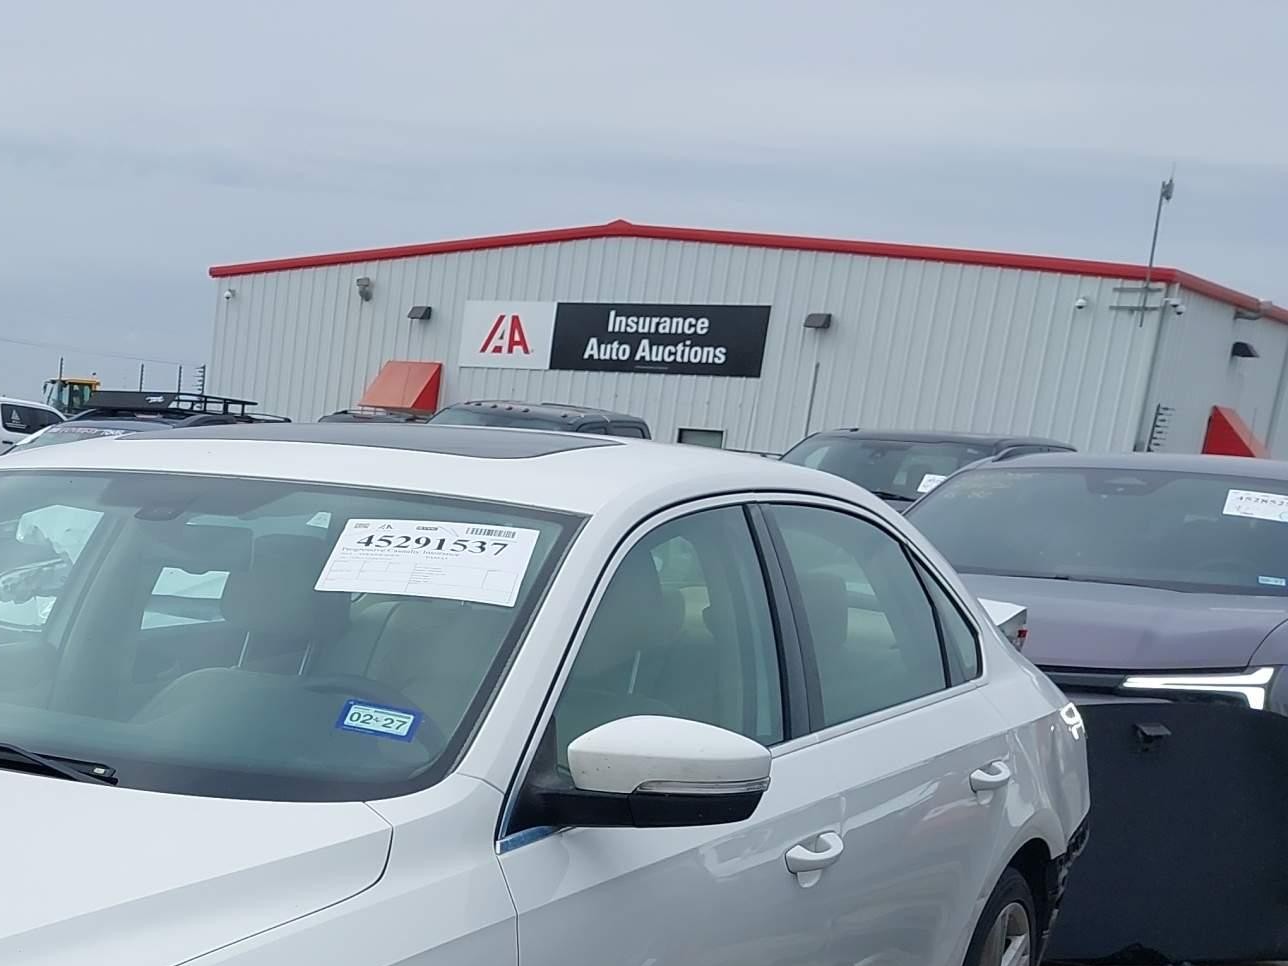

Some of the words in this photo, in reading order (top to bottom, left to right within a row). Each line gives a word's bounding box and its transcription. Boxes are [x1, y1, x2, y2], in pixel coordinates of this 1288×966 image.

[607, 309, 710, 335] Insurance
[583, 337, 631, 361] Auto
[633, 338, 727, 364] Auctions
[356, 534, 509, 556] 45291537
